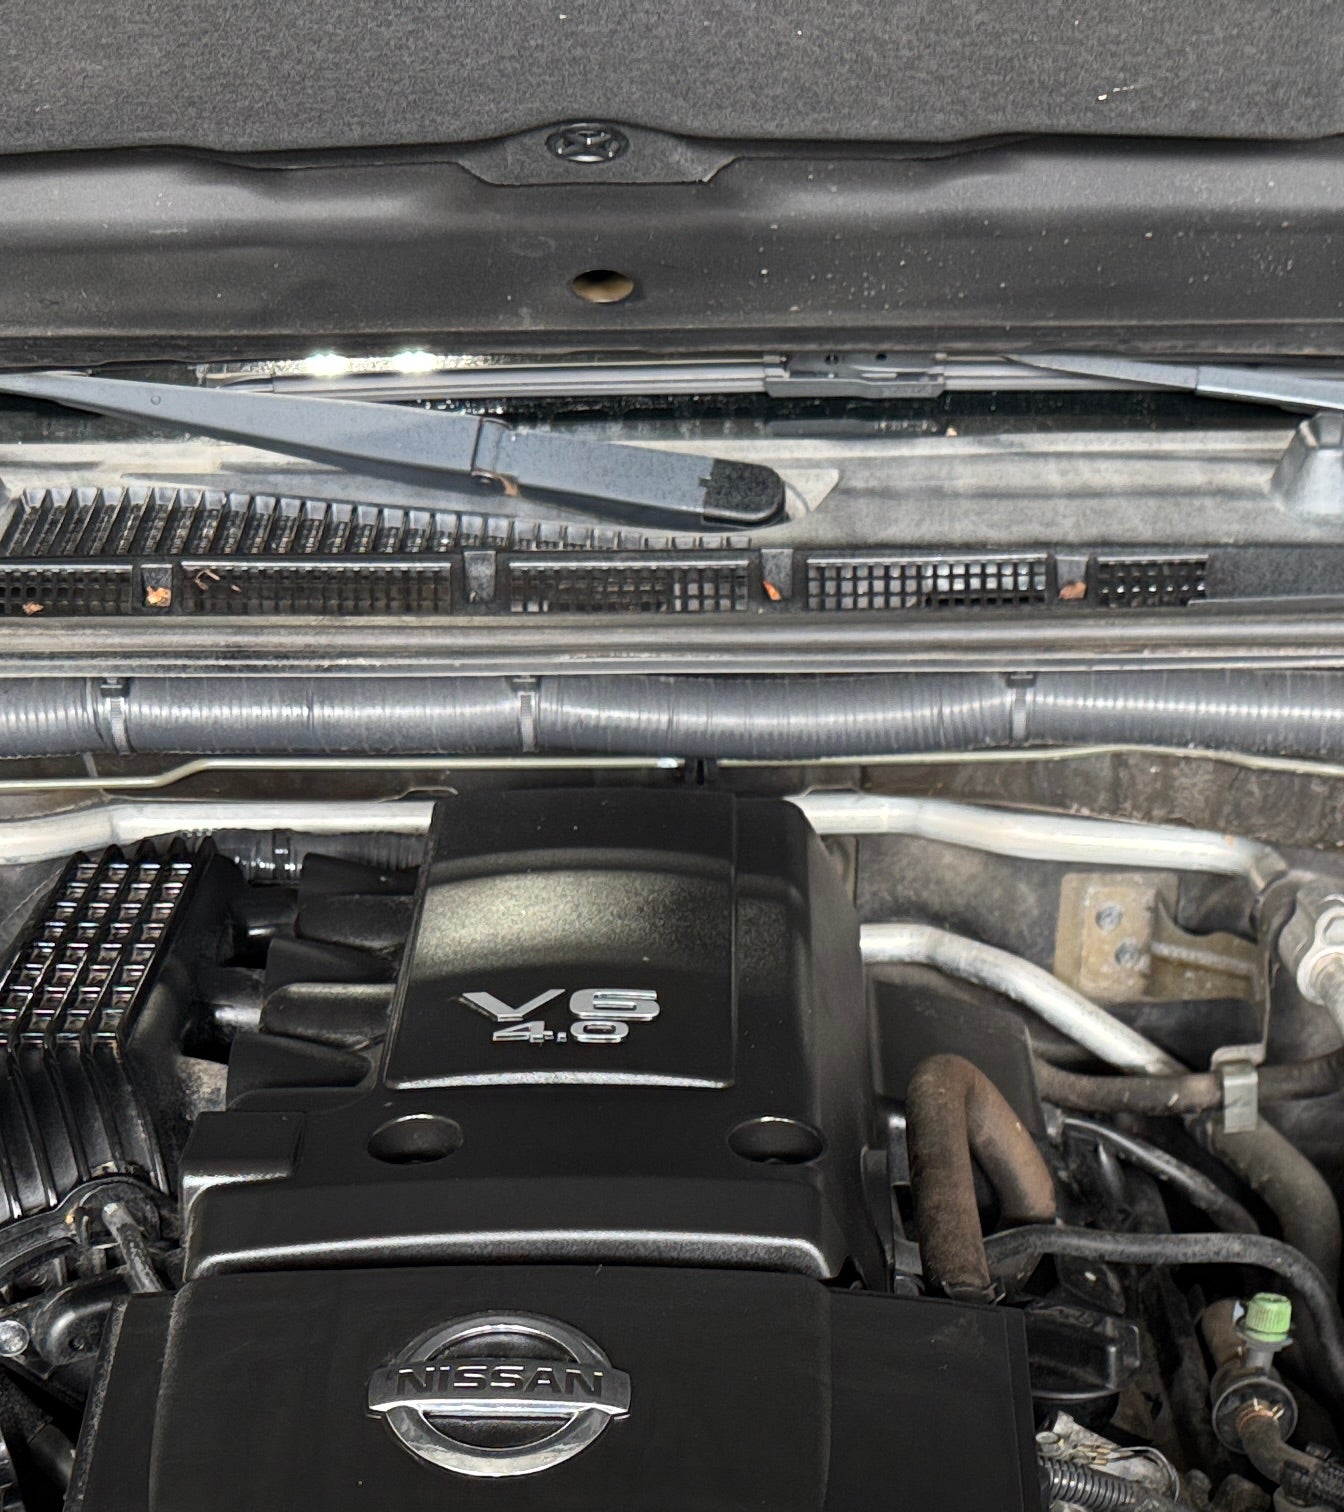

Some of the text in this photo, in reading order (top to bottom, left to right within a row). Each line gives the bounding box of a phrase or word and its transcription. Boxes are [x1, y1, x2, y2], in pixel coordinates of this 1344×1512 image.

[460, 988, 660, 1022] V6
[492, 1021, 629, 1043] 4.0
[396, 1366, 605, 1398] NISSAN
